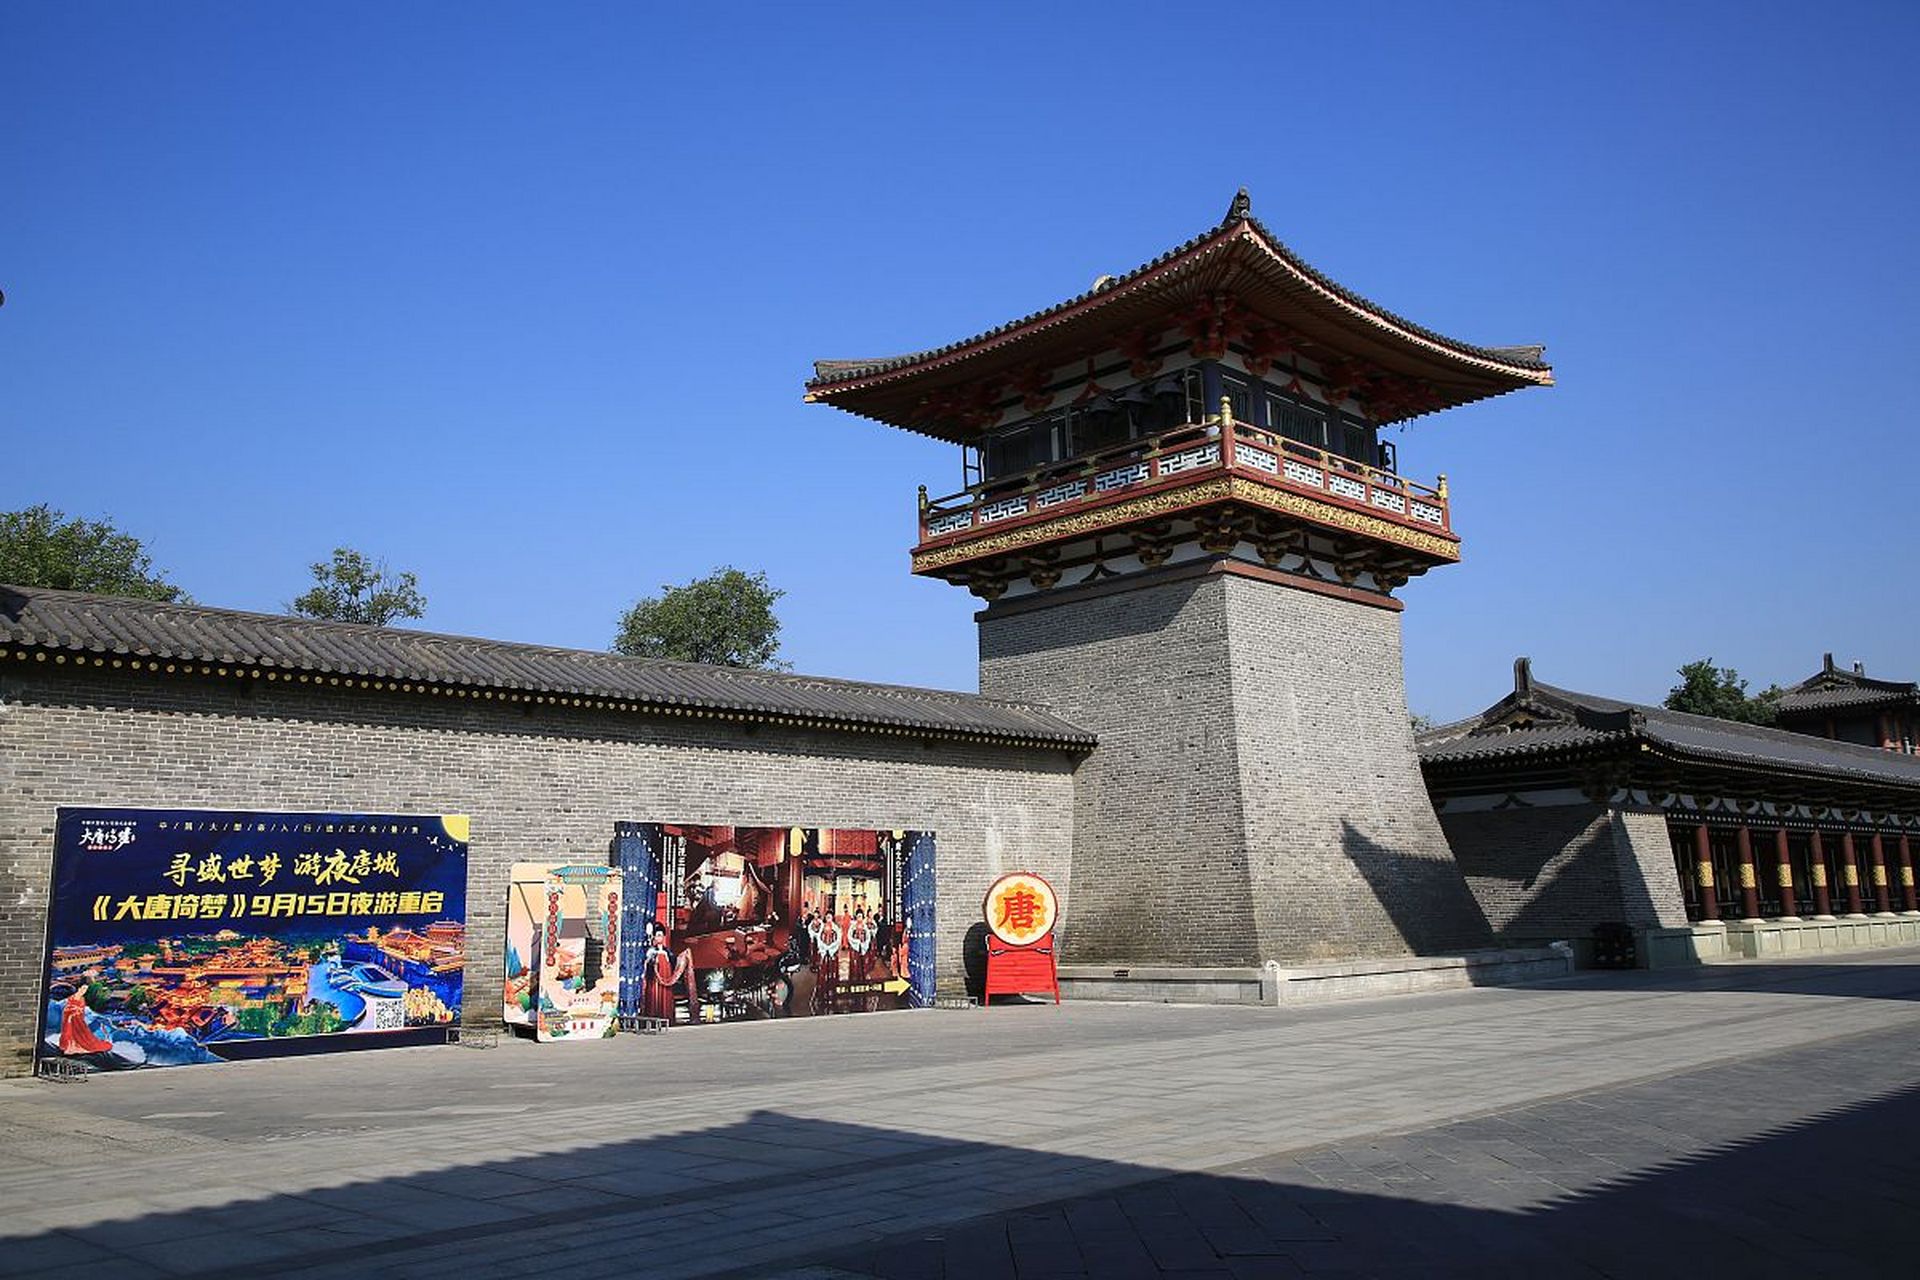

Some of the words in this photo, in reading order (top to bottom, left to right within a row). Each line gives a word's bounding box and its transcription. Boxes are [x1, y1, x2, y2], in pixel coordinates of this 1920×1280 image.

[163, 853, 282, 887] 寻盛世梦
[92, 891, 444, 920] 《大唐倚梦》9月15日夜游重启
[998, 891, 1041, 929] 唐
